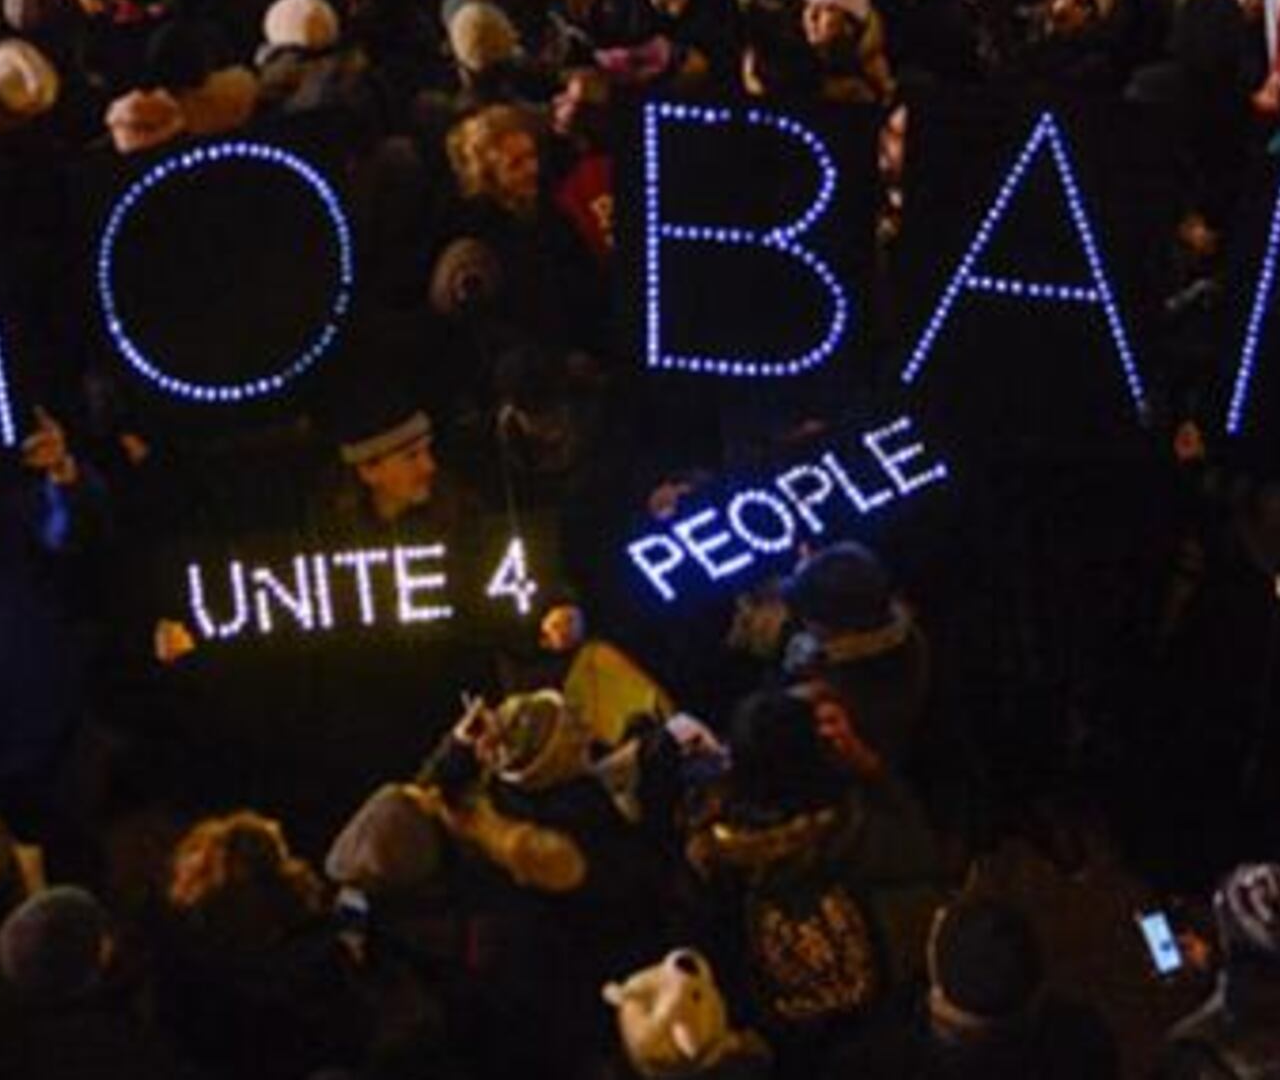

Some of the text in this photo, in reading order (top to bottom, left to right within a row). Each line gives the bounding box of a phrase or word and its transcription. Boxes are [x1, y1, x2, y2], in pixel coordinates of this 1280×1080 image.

[627, 416, 946, 600] PEOPLE
[185, 536, 537, 640] UNITE 4
